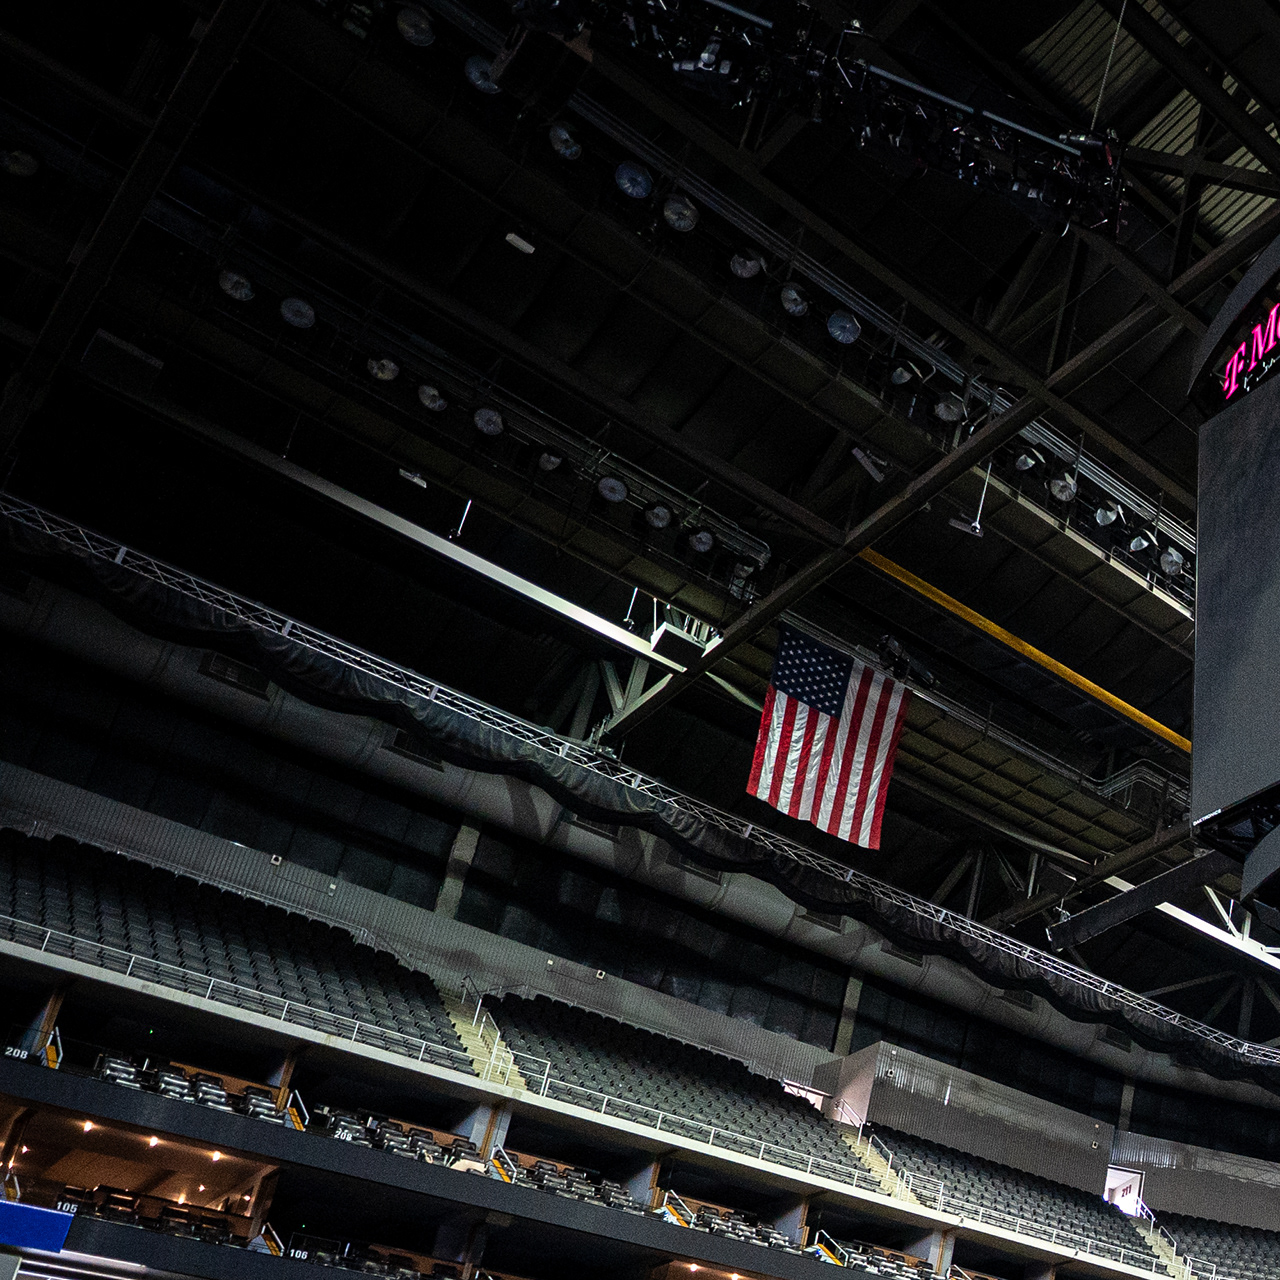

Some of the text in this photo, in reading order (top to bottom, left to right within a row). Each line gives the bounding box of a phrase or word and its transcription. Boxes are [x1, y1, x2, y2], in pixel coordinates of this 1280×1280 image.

[5, 1047, 27, 1060] 208
[335, 1129, 353, 1141] 208
[1121, 1184, 1132, 1197] 211
[56, 1201, 78, 1214] 105
[290, 1249, 308, 1260] 106
